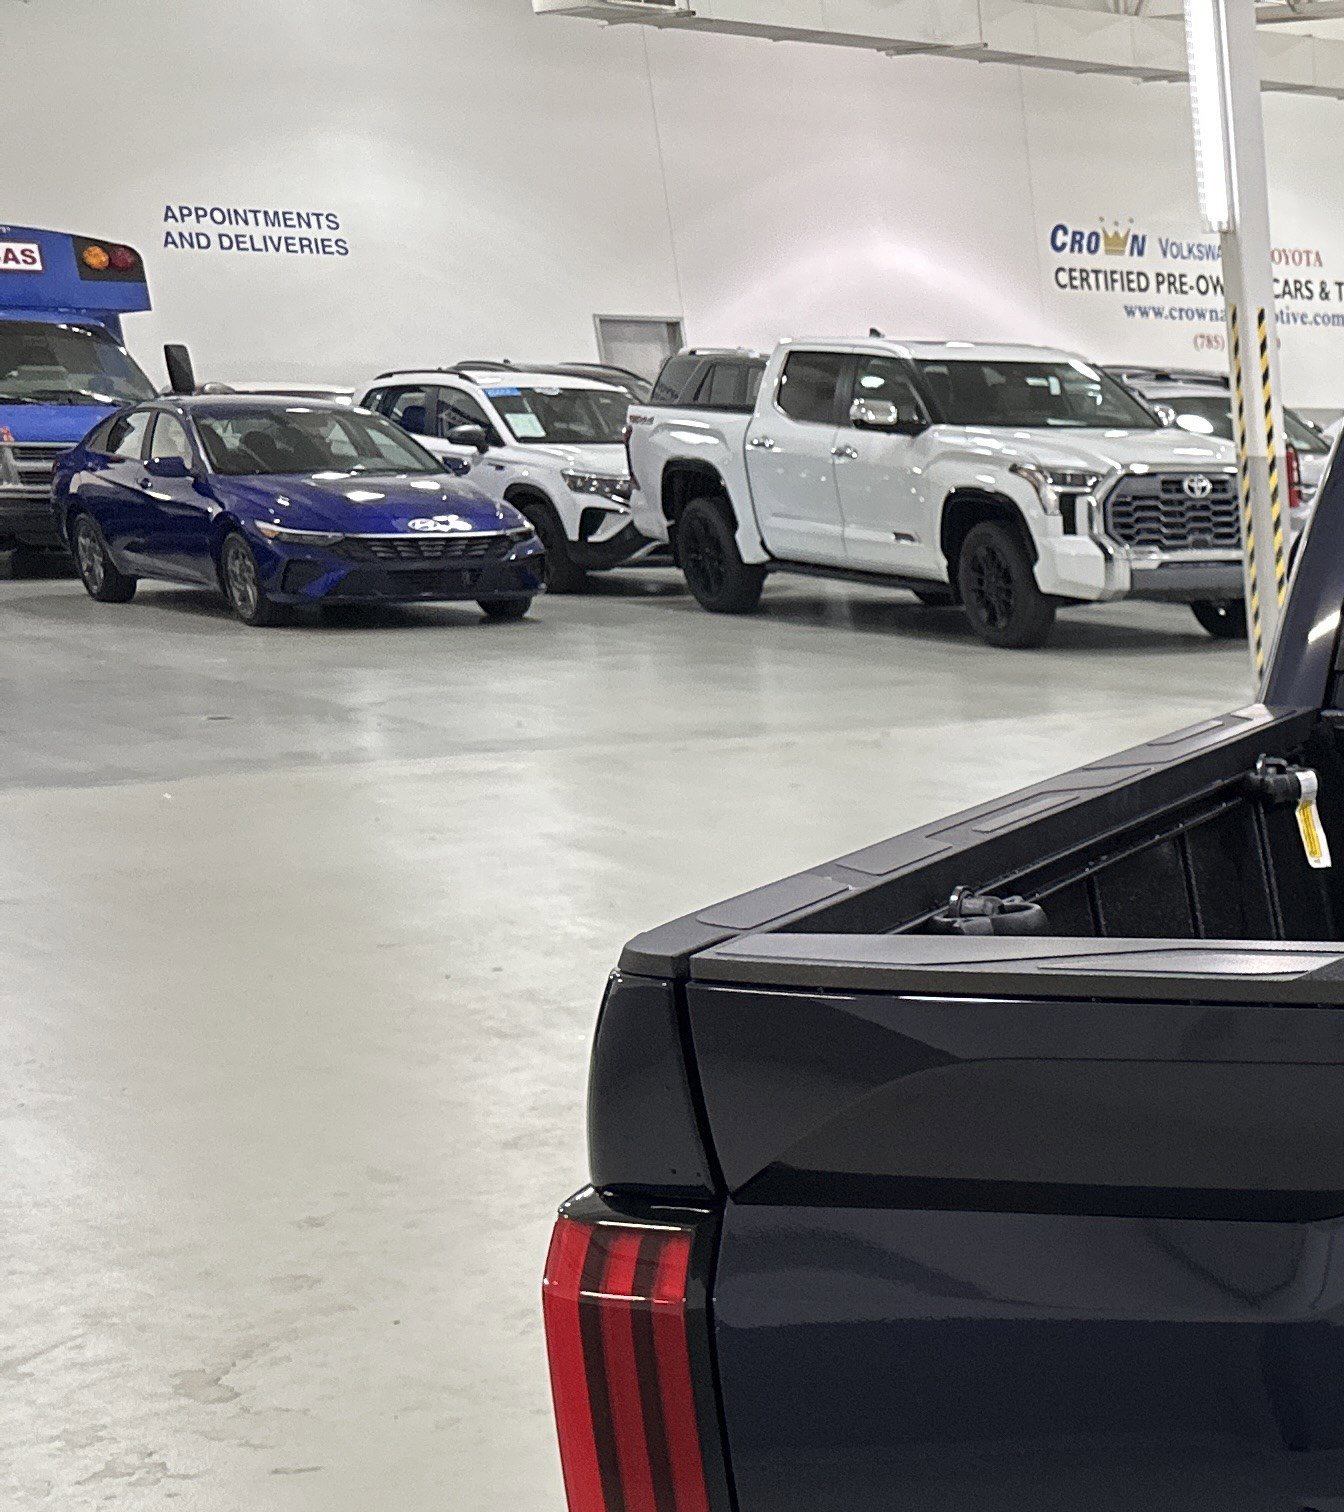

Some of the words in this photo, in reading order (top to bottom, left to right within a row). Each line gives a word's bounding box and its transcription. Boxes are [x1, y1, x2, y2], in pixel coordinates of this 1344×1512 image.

[163, 205, 340, 231] APPOINTMENTS
[163, 231, 211, 250] AND
[218, 233, 349, 256] DELIVERIES
[0, 247, 38, 266] AS
[1270, 247, 1323, 268] OYOTA
[1054, 266, 1150, 293] CERTIFIED
[1155, 272, 1225, 297] PRE-OW
[1319, 280, 1331, 301] &
